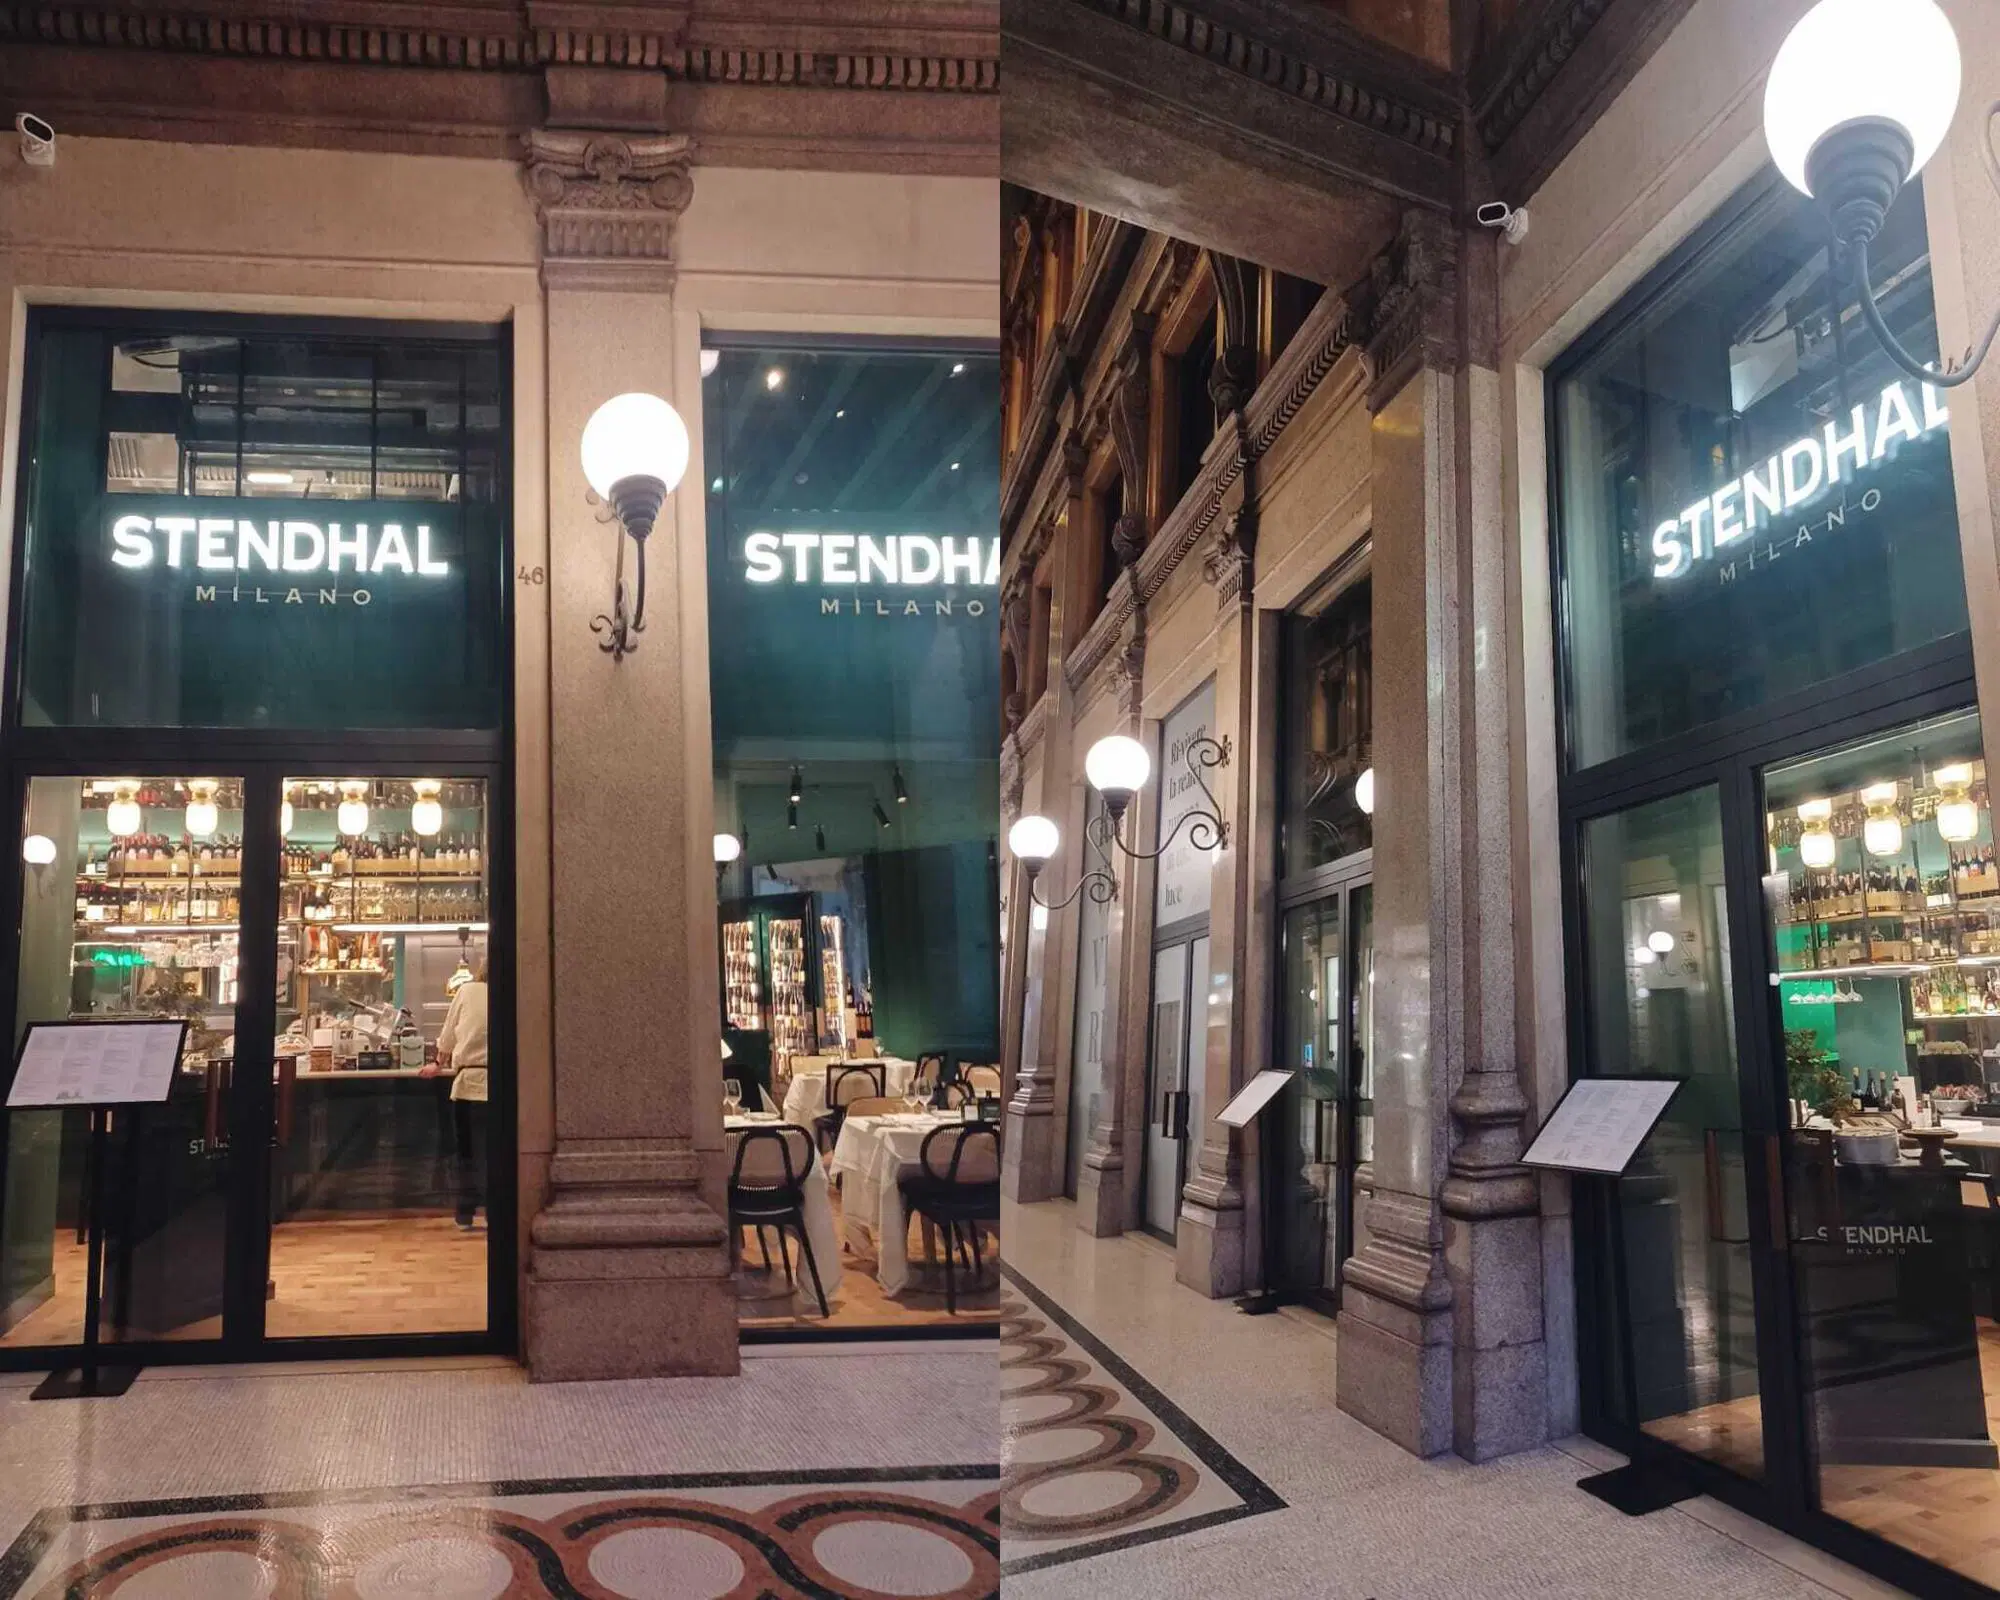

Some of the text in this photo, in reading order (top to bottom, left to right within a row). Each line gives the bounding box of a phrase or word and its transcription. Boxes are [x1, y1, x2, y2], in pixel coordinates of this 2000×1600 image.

[1651, 361, 1949, 578] STENDHAL
[110, 515, 449, 576] STENDHAL
[1719, 488, 1882, 585] MILANO
[517, 566, 544, 585] 46
[195, 585, 373, 606] MILANO
[820, 598, 984, 617] MILANO
[1816, 1225, 1933, 1245] SENDHAL
[1846, 1247, 1906, 1255] MILANO
